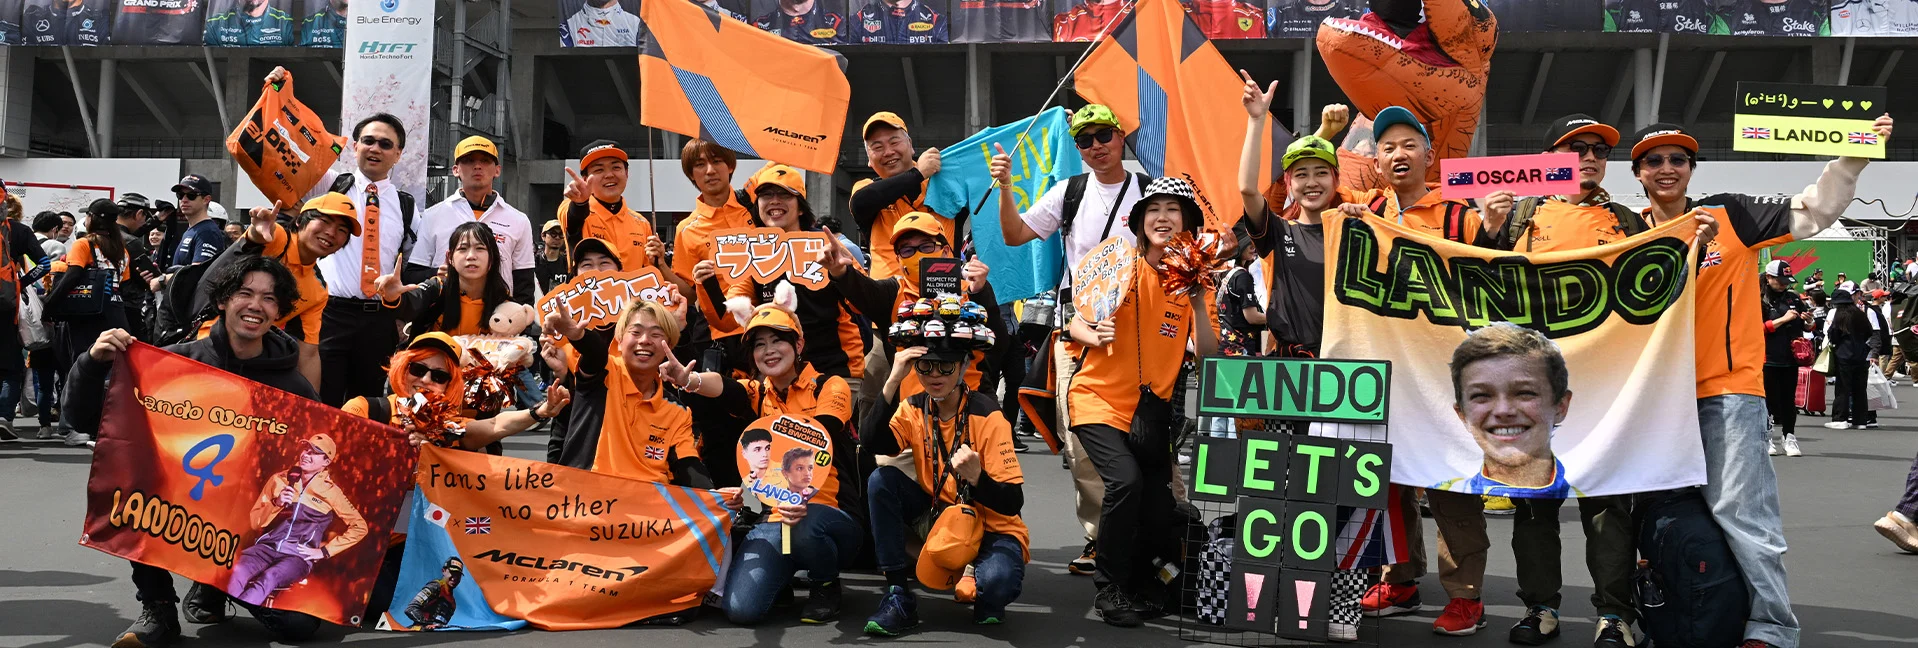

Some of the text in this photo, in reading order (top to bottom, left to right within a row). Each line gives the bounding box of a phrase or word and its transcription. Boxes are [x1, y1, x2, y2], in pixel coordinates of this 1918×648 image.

[159, 0, 181, 8] PRIX
[357, 15, 422, 25] Blue Energy
[1674, 15, 1706, 32] Stake
[1782, 17, 1815, 32] Stake
[79, 34, 98, 42] INEOS
[358, 41, 418, 53] HTFT
[910, 35, 933, 43] BYBIT
[763, 126, 827, 144] McLaren
[1774, 128, 1843, 143] LANDO
[1476, 168, 1543, 186] OSCAR
[716, 233, 779, 246] マクラーレン
[802, 261, 824, 283] 4
[1075, 259, 1110, 295] PAPAYA
[1335, 218, 1690, 339] LANDO
[1202, 360, 1384, 413] LANDO
[133, 386, 288, 435] Lando Norris
[780, 418, 794, 428] It's
[430, 463, 555, 491] Fans like
[1195, 437, 1384, 497] LET'S
[752, 479, 802, 505] LANDO
[498, 493, 619, 520] no other
[110, 487, 240, 569] LANDOOO!
[589, 518, 674, 542] SUZUKA
[1242, 508, 1330, 561] GO
[472, 549, 649, 582] McLaren
[503, 573, 560, 585] FORMULA
[583, 582, 619, 598] TEAM
